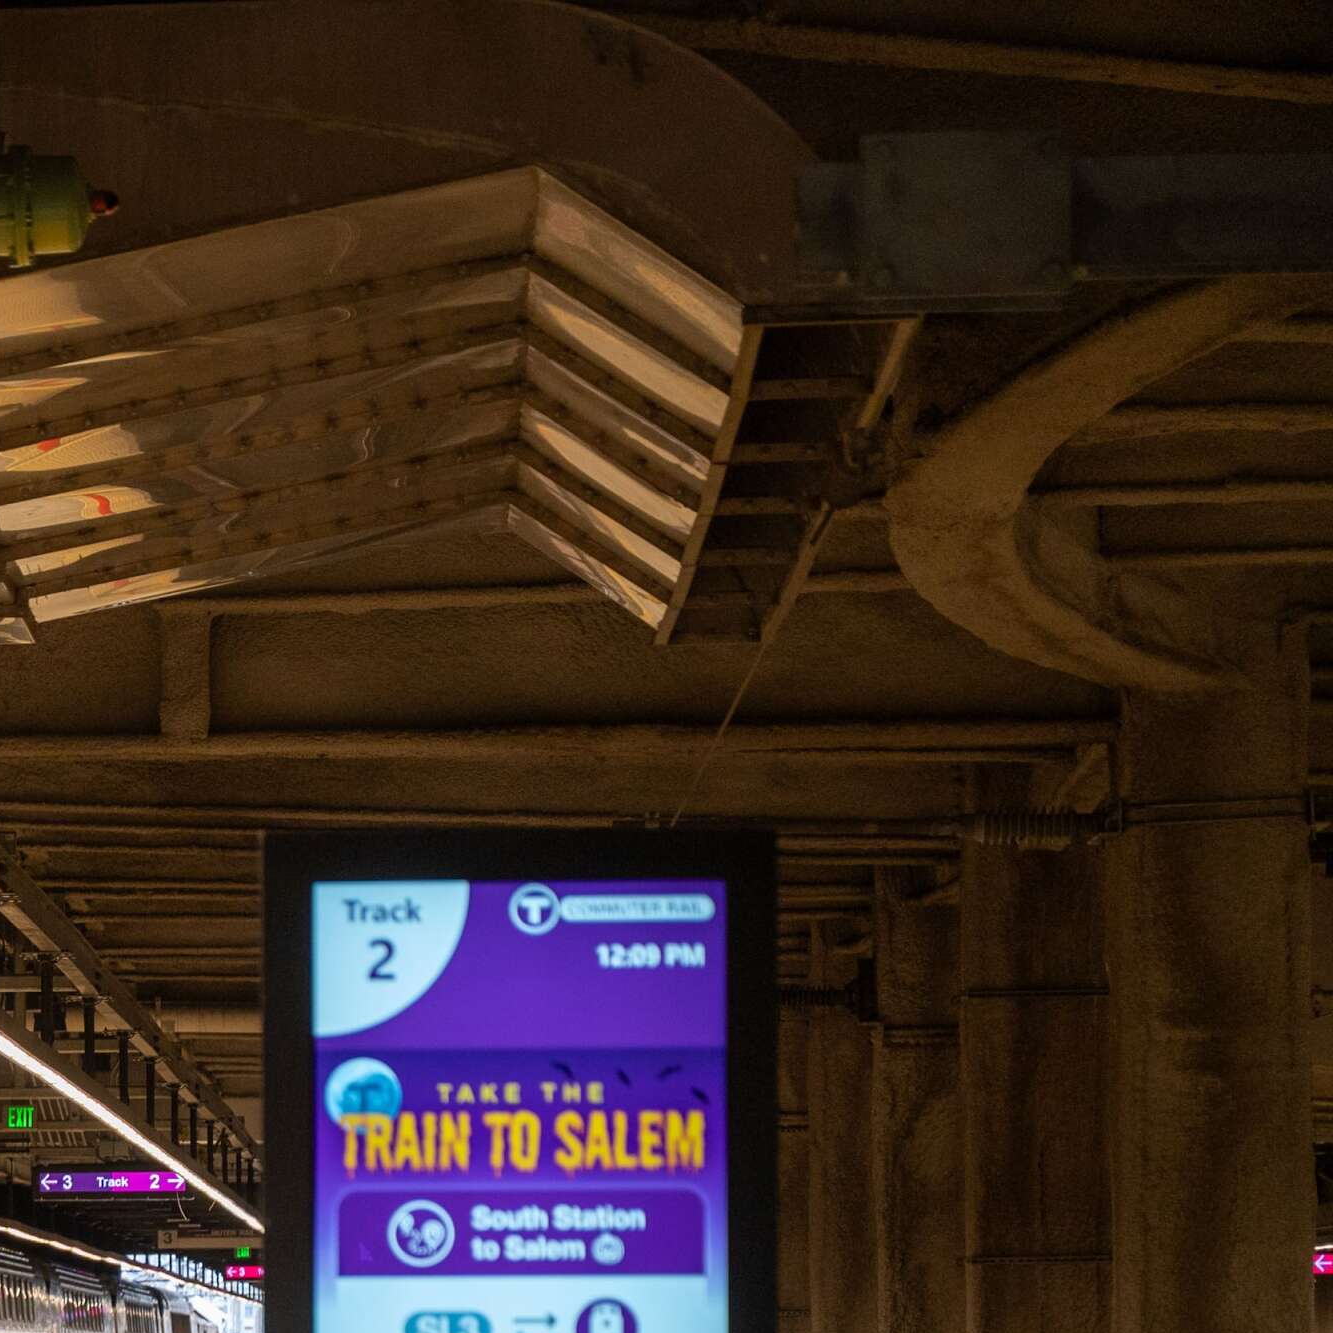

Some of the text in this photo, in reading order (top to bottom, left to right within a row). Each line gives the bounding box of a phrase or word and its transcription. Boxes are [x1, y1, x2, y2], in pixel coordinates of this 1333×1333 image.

[343, 898, 422, 924] Track
[367, 939, 397, 980] 2
[664, 943, 706, 968] PM
[437, 1082, 605, 1104] TAKE THE
[7, 1107, 34, 1128] EXIT
[339, 1111, 705, 1173] TRAIN TO SALEM
[62, 1174, 160, 1190] 3 Track 2
[470, 1204, 646, 1231] South Station
[470, 1234, 586, 1262] to Salem
[239, 1267, 246, 1277] 3
